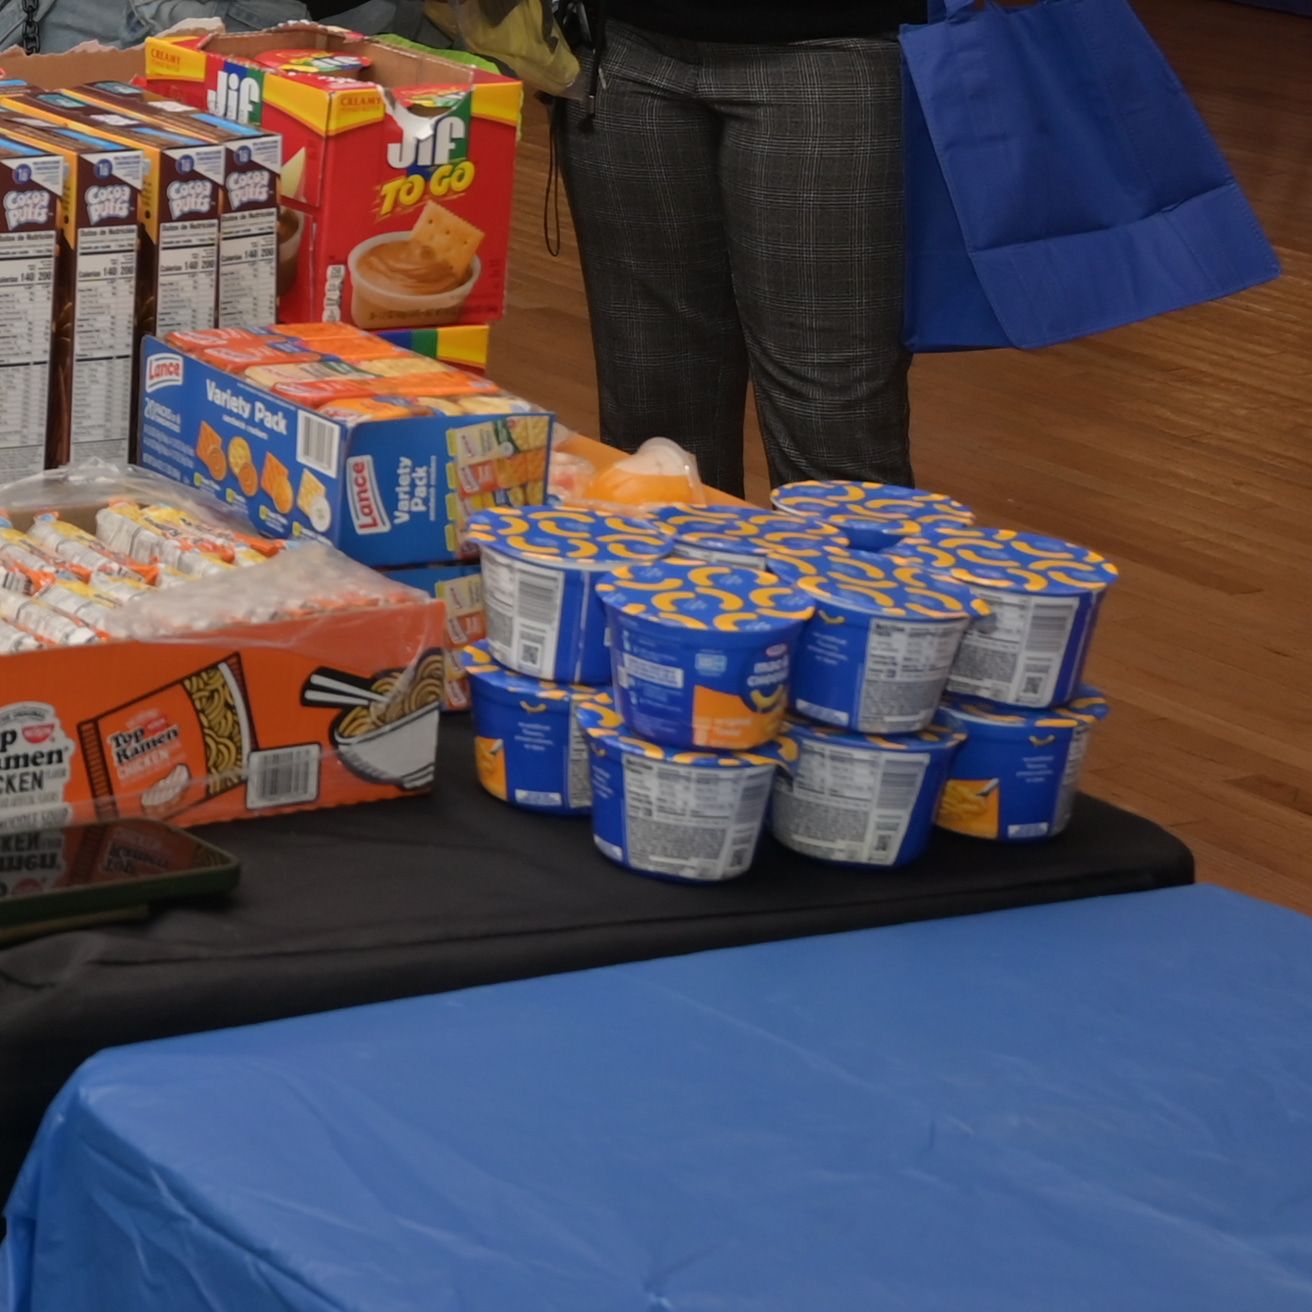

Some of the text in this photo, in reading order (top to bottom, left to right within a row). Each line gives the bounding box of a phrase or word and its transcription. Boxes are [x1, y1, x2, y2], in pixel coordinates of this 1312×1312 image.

[206, 70, 261, 123] Jif
[386, 116, 466, 169] Jif
[379, 160, 475, 217] TO GO
[149, 359, 180, 380] Lance
[206, 379, 288, 435] Variety Pack
[352, 459, 379, 530] Lance
[394, 456, 412, 524] Variety
[411, 466, 428, 512] Pack
[111, 726, 145, 749] Top
[116, 726, 180, 765] Ramen
